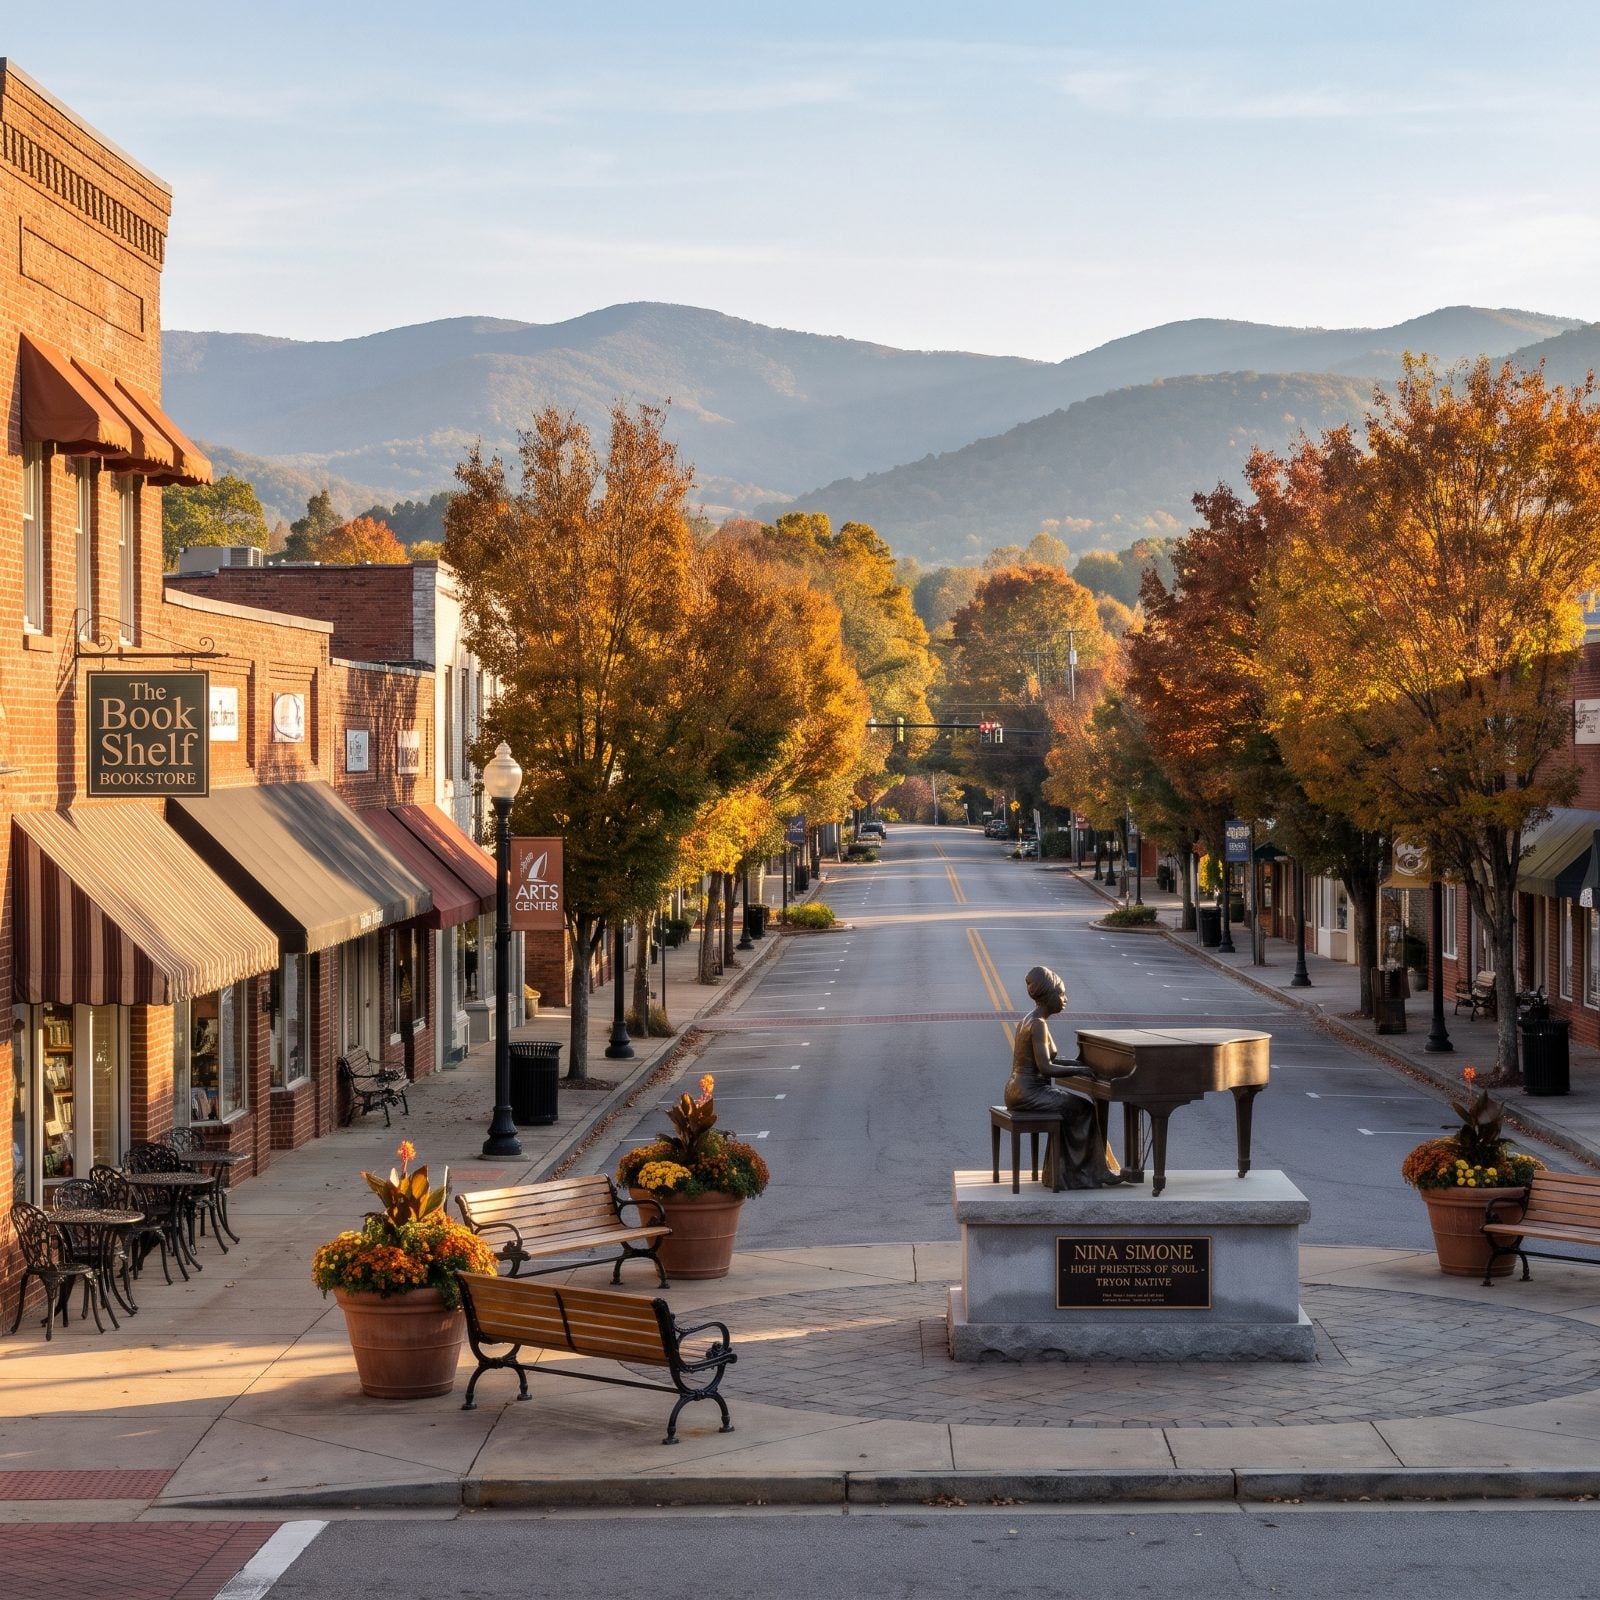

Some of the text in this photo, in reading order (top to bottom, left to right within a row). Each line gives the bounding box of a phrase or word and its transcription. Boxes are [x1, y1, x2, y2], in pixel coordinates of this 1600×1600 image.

[129, 682, 167, 701] The
[98, 696, 198, 730] Book
[101, 732, 199, 767] Shelf
[99, 772, 197, 785] BOOKSTORE
[515, 884, 559, 900] ARTS
[515, 901, 559, 911] CENTER
[1074, 1244, 1194, 1260] NINA SIMONE
[1100, 1264, 1151, 1274] PRIESTESS
[1154, 1264, 1168, 1274] OF
[1171, 1264, 1198, 1274] SOUL
[1096, 1277, 1172, 1287] TRYON NATIVE
